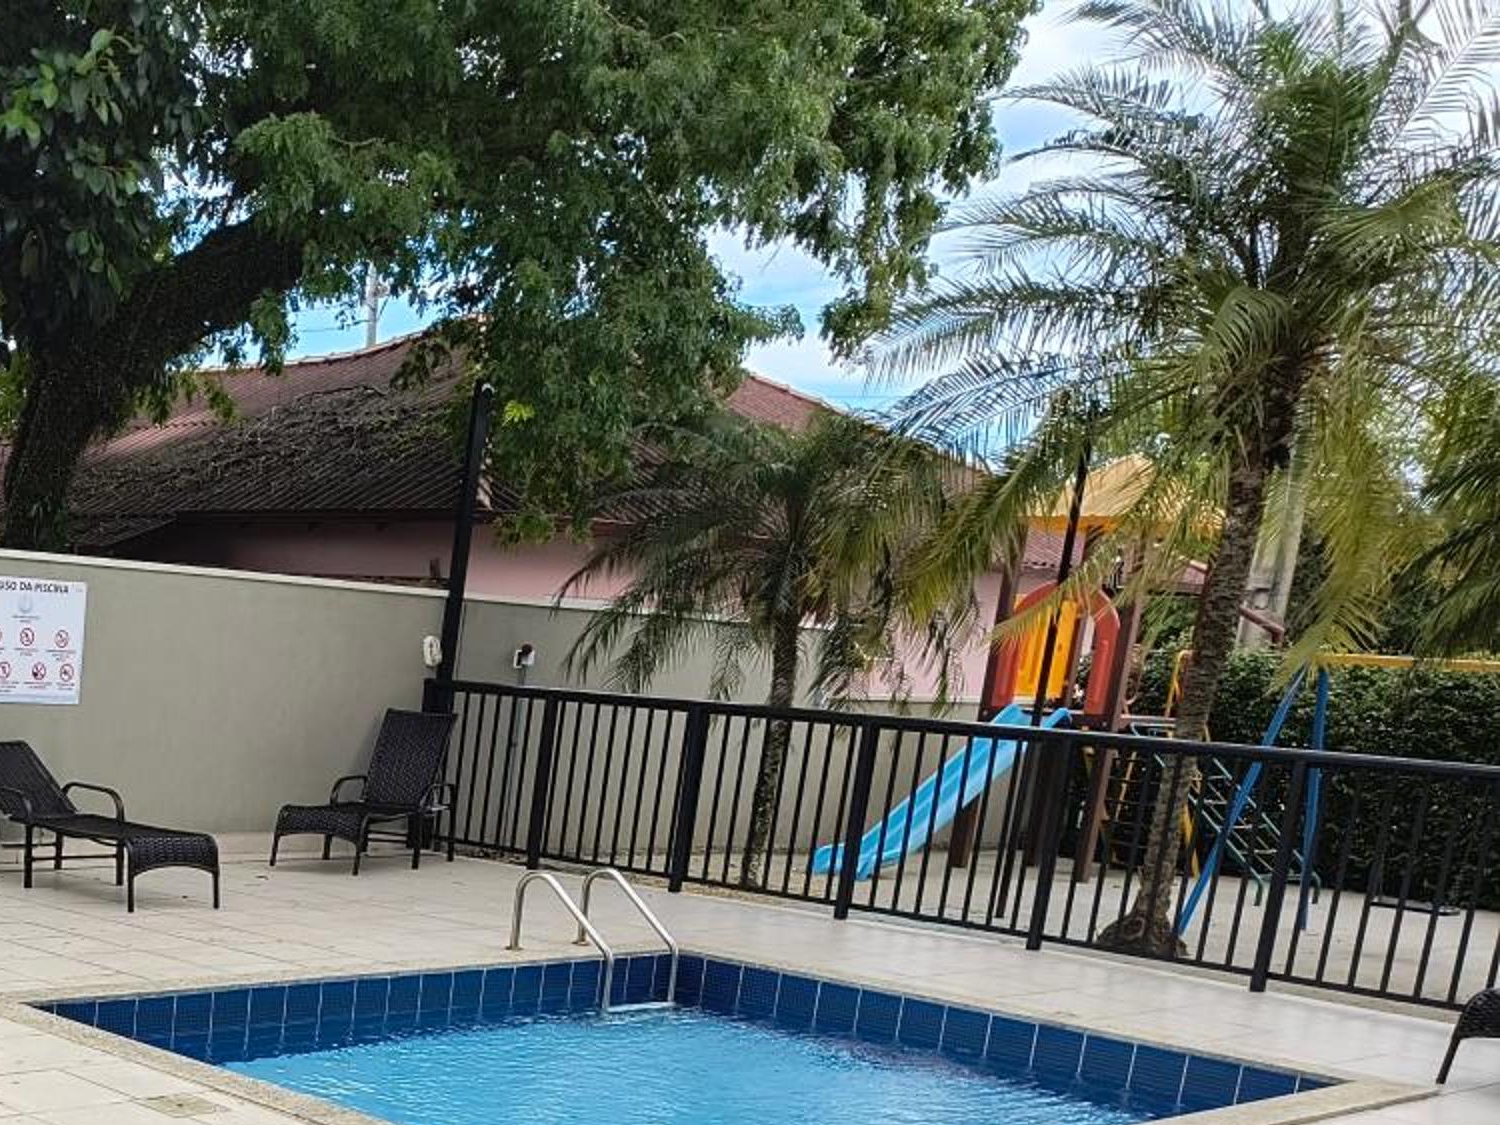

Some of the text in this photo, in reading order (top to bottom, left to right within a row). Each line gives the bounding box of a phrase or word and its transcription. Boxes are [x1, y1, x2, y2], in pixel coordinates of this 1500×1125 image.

[0, 580, 17, 591] USO
[19, 581, 33, 591] DA
[34, 583, 69, 594] PISCINA
